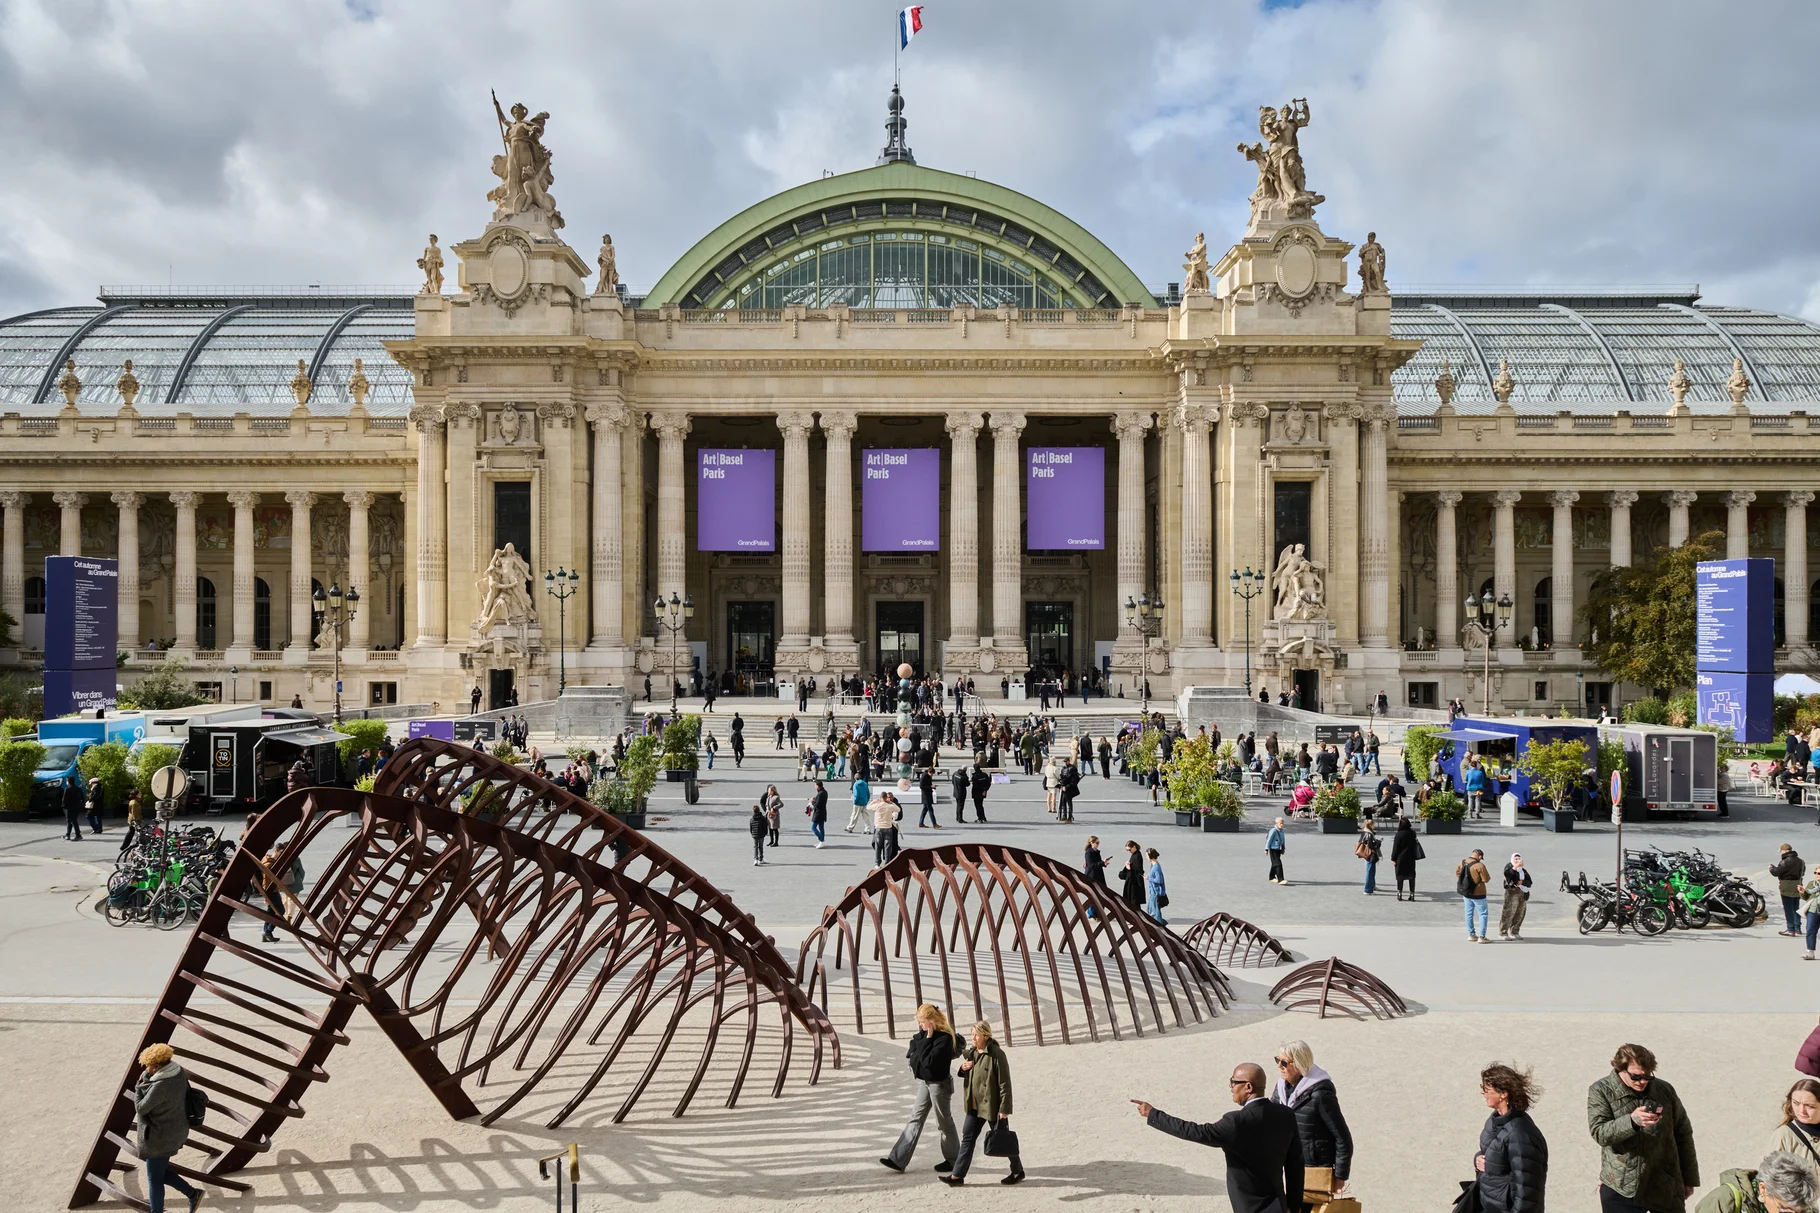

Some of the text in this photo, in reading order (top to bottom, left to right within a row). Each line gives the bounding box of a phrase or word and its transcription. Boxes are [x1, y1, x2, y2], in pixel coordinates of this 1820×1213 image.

[703, 468, 725, 479] Paris
[867, 468, 889, 479] Paris
[1032, 467, 1054, 478] Paris
[74, 560, 82, 568] Cet
[1697, 675, 1713, 685] Plan
[72, 691, 103, 700] Vibrer dans
